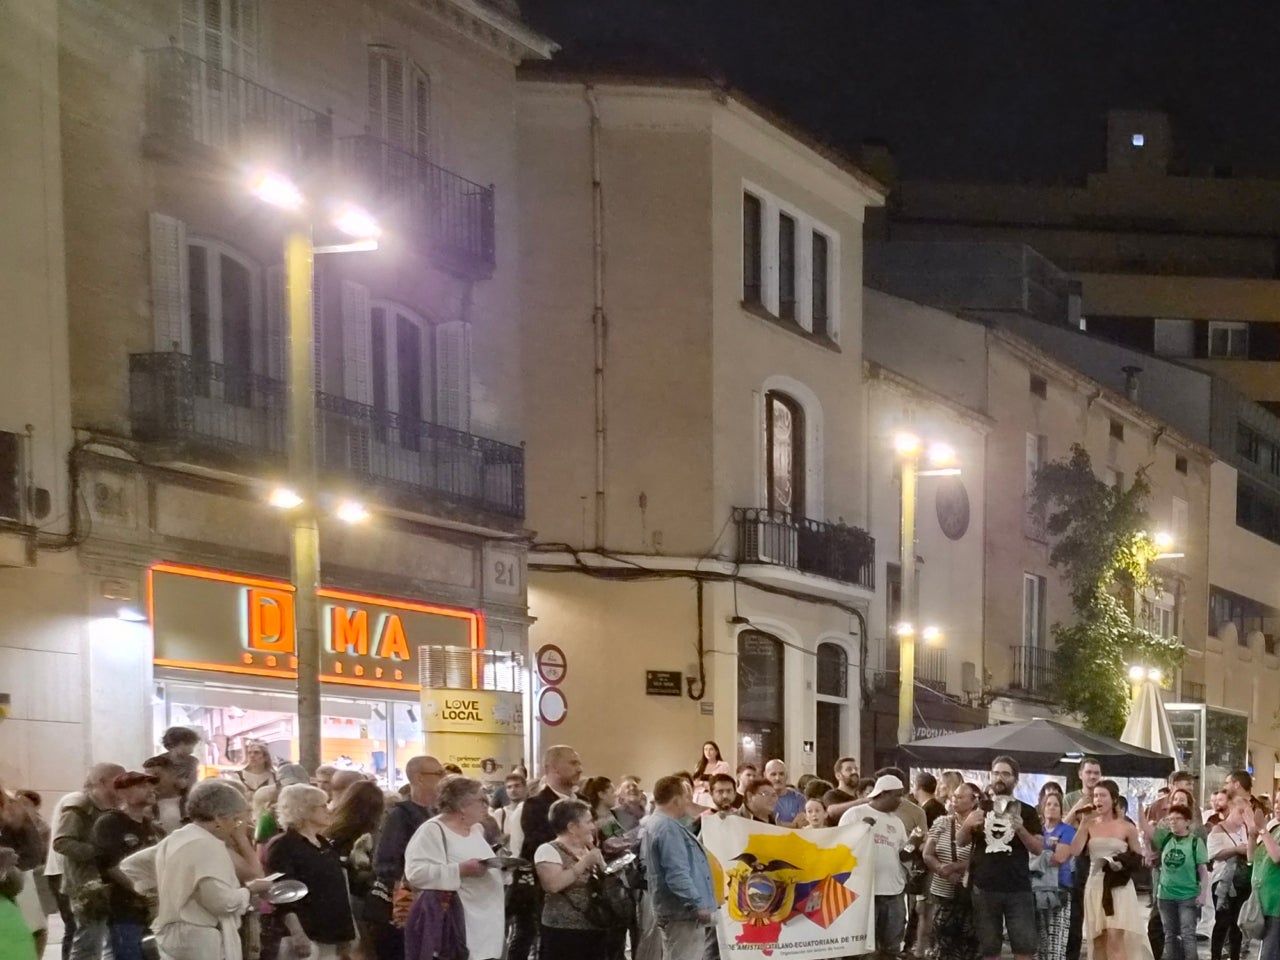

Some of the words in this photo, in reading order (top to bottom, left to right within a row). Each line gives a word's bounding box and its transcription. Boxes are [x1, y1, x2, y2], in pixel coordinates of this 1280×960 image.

[494, 561, 515, 587] 21
[243, 587, 411, 661] DMA
[445, 700, 479, 710] LOVE
[442, 710, 483, 721] LOCAL
